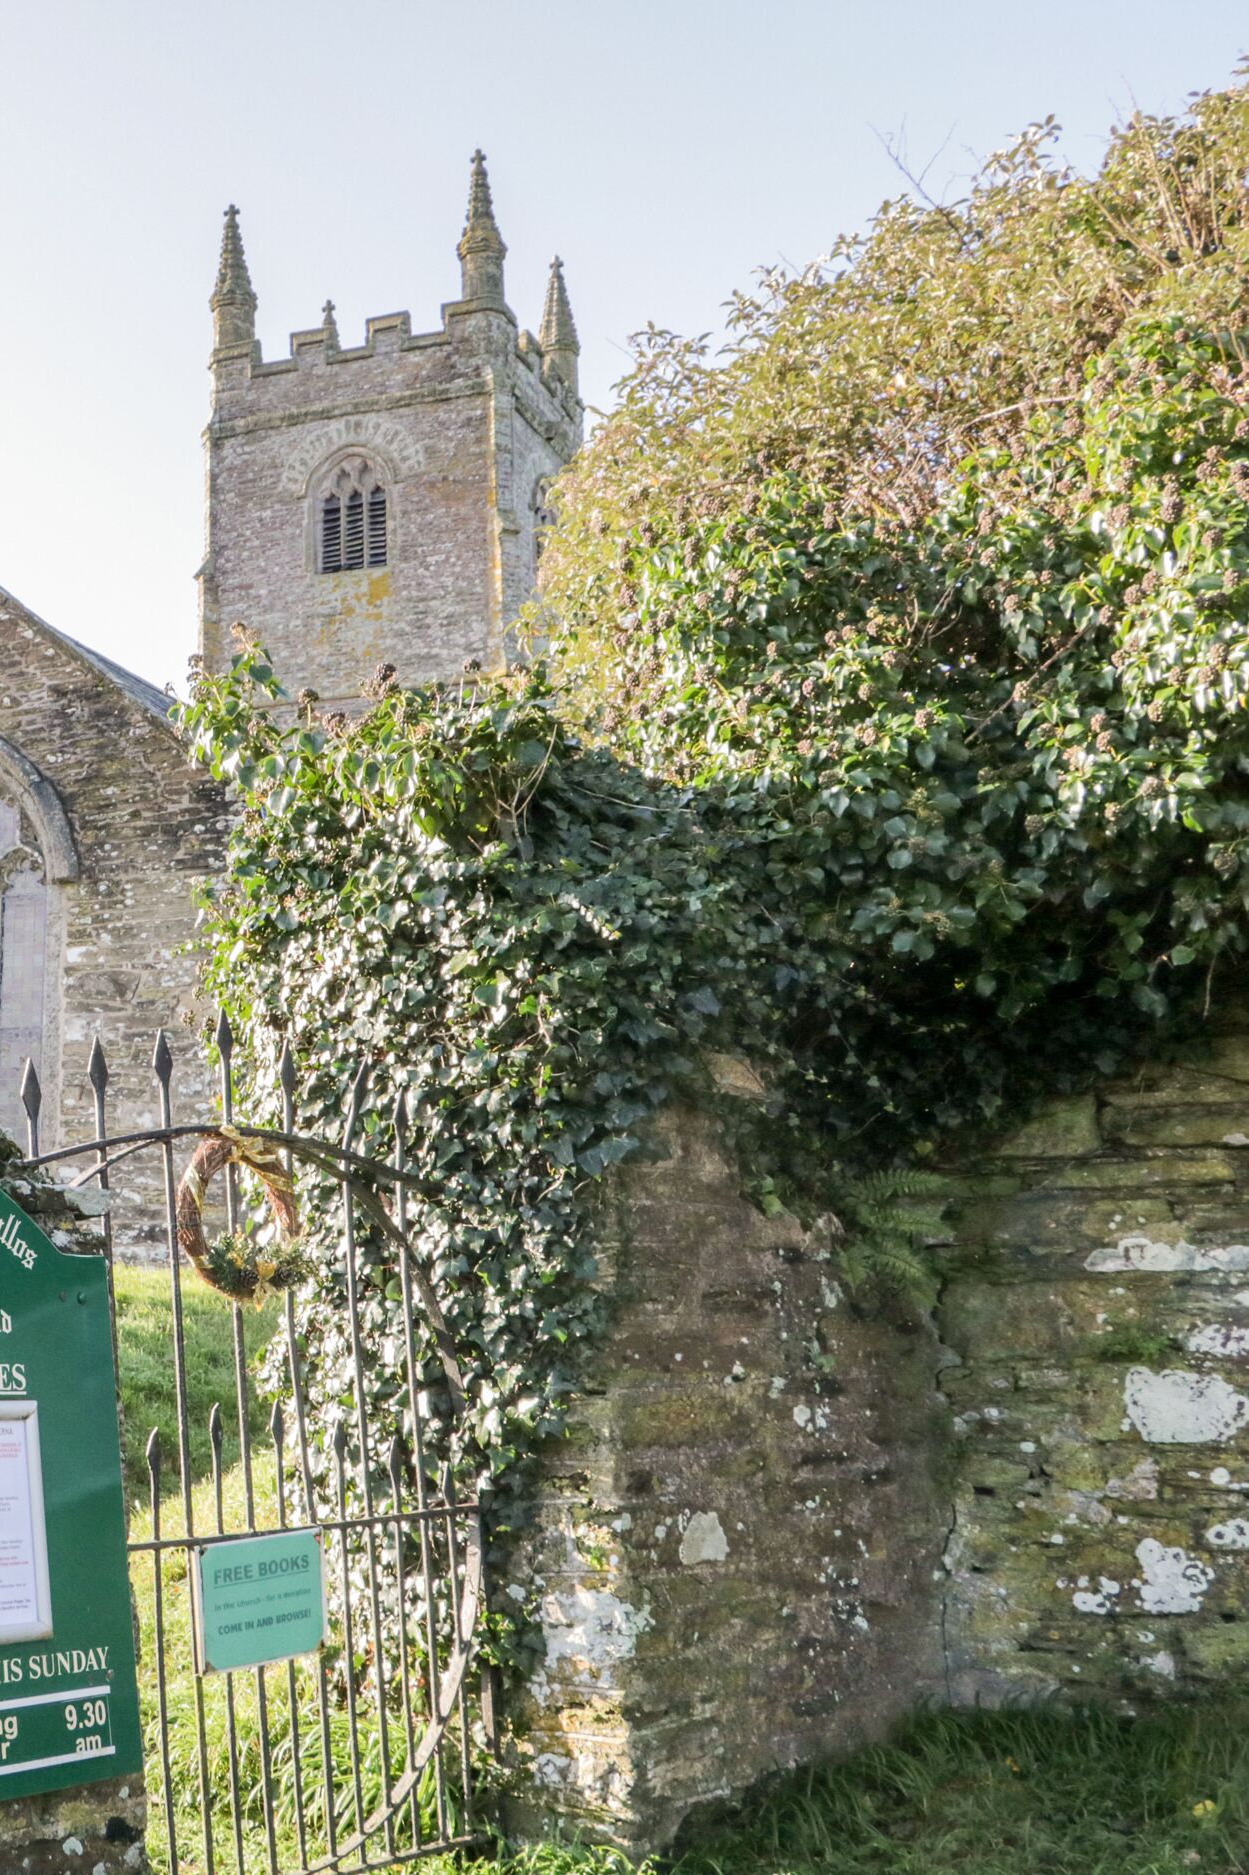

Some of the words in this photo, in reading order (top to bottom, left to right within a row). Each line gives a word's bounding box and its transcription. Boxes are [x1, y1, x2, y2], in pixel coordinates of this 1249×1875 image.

[214, 1564, 253, 1585] FREE
[259, 1554, 310, 1577] BOOKS
[218, 1622, 243, 1635] COME
[245, 1620, 254, 1630] IN
[257, 1617, 274, 1628] AND
[275, 1608, 311, 1624] BROWSE!
[29, 1647, 109, 1679] SUNDAY
[65, 1700, 106, 1731] 9.30
[76, 1733, 101, 1753] am
